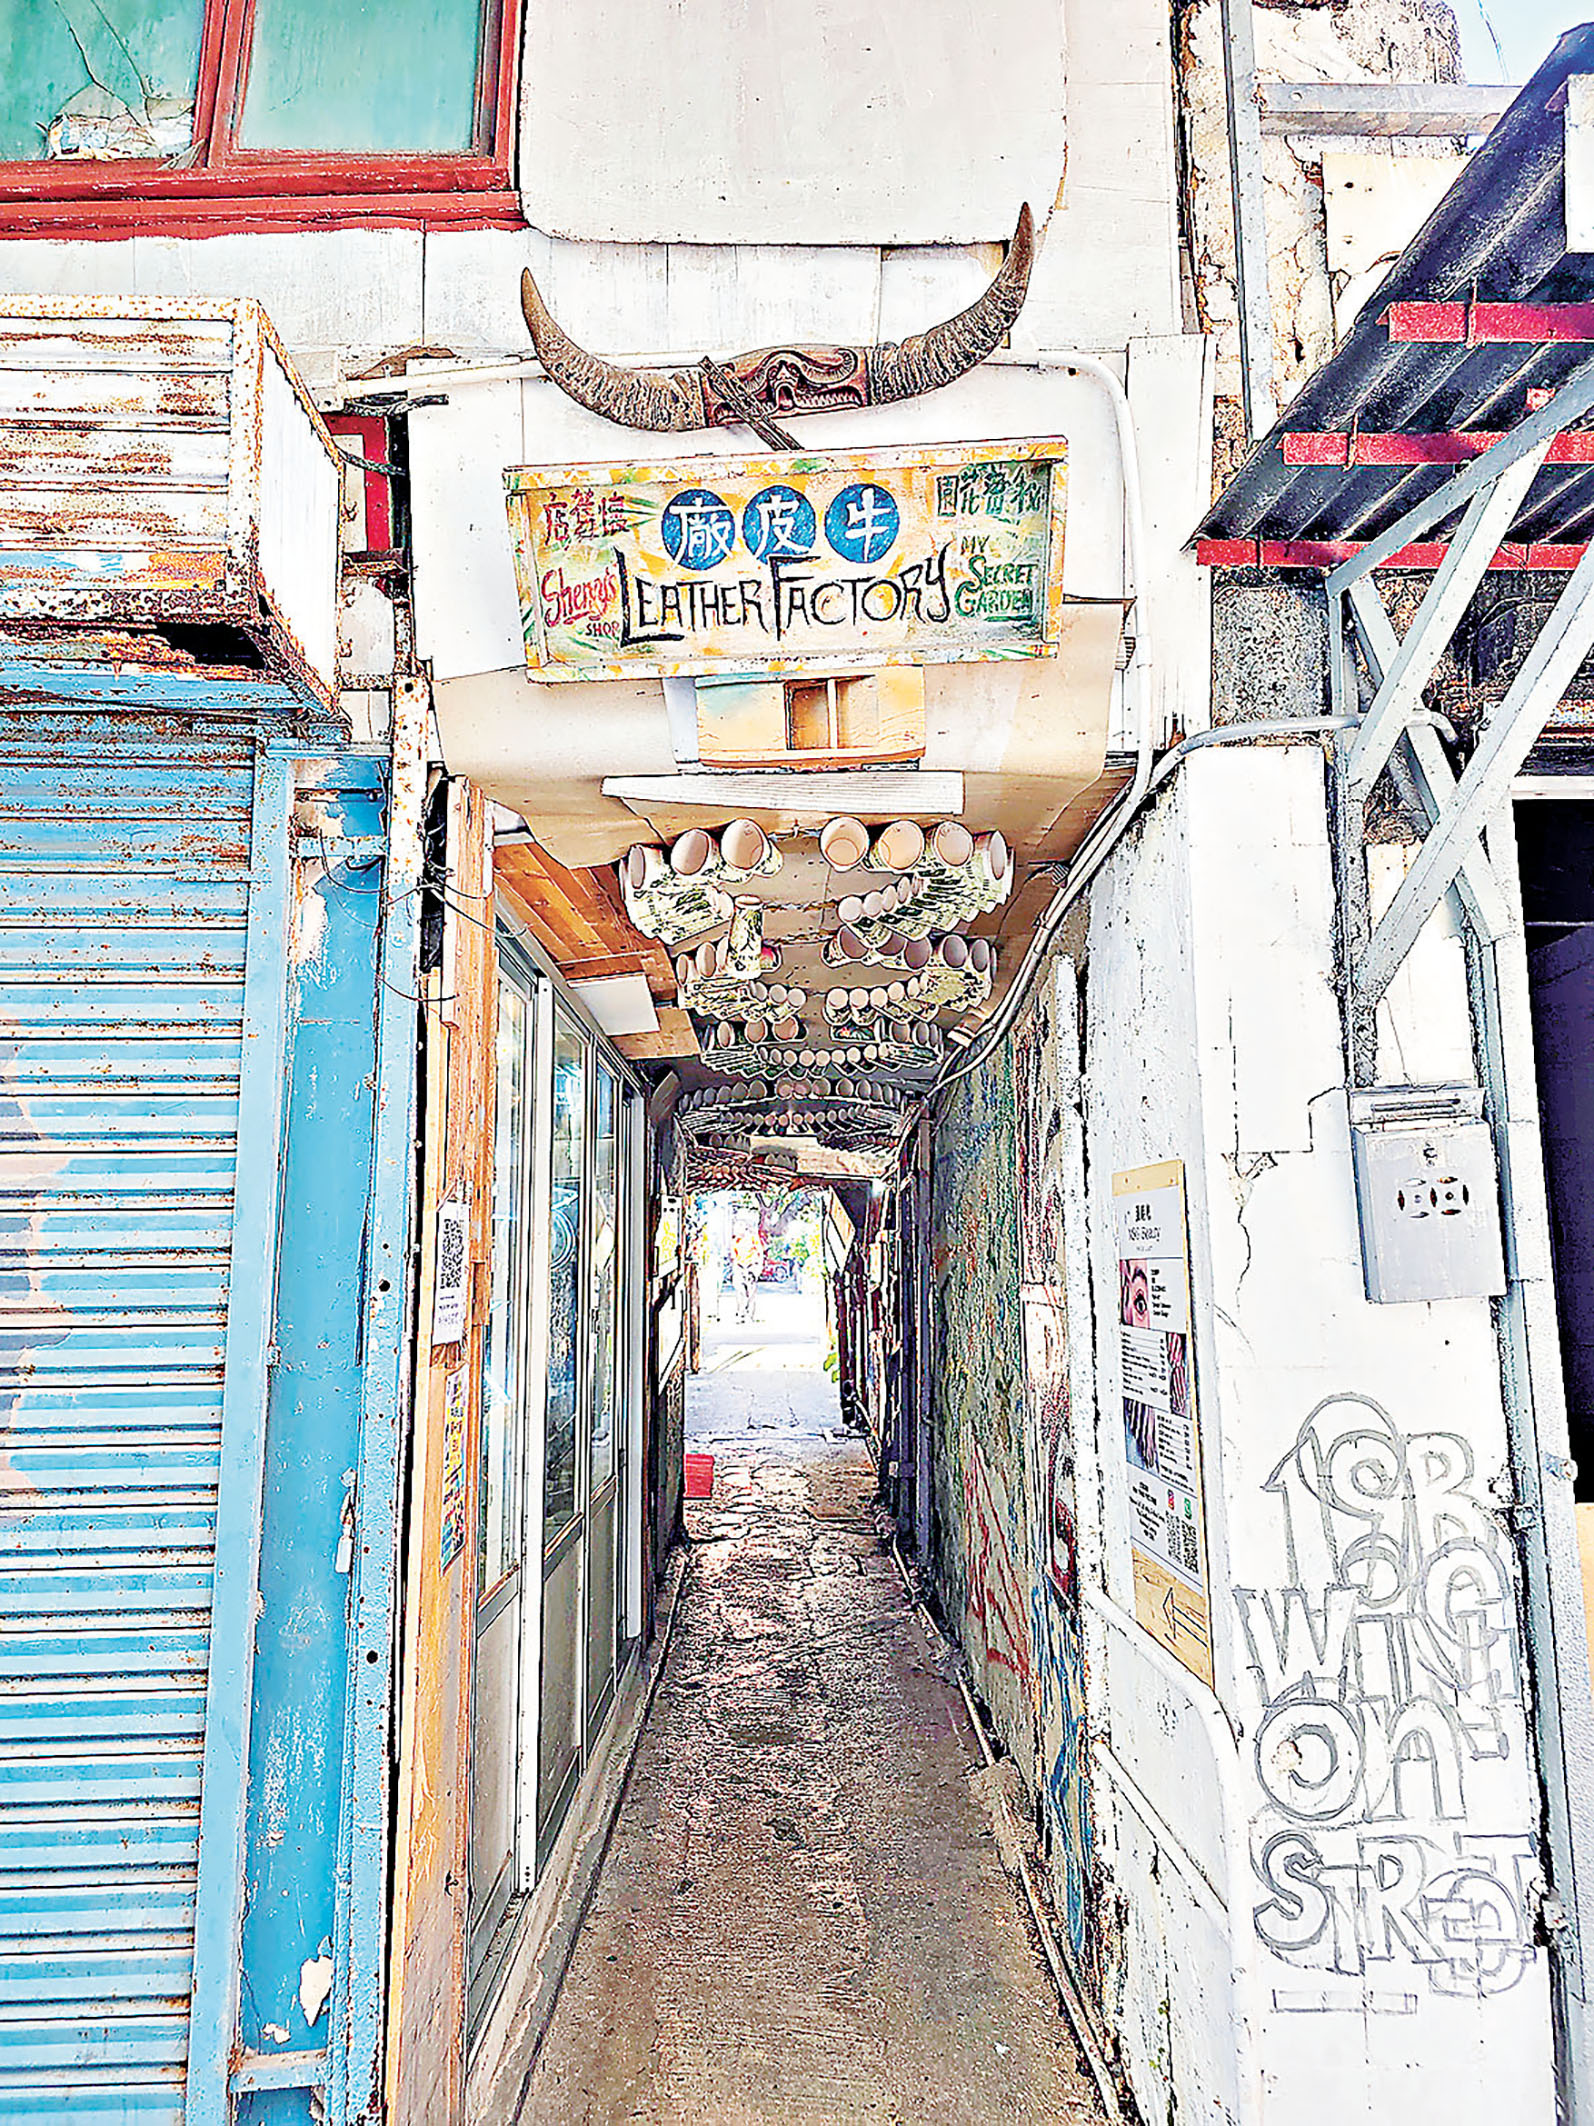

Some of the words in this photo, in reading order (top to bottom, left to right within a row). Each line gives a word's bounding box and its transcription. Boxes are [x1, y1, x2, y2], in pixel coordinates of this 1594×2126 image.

[960, 535, 990, 555] MY
[968, 554, 1040, 588] SECRET
[613, 546, 769, 648] LEATHER
[768, 541, 952, 641] FACTORY
[954, 580, 1034, 618] GARDEN
[585, 621, 620, 637] SHOP
